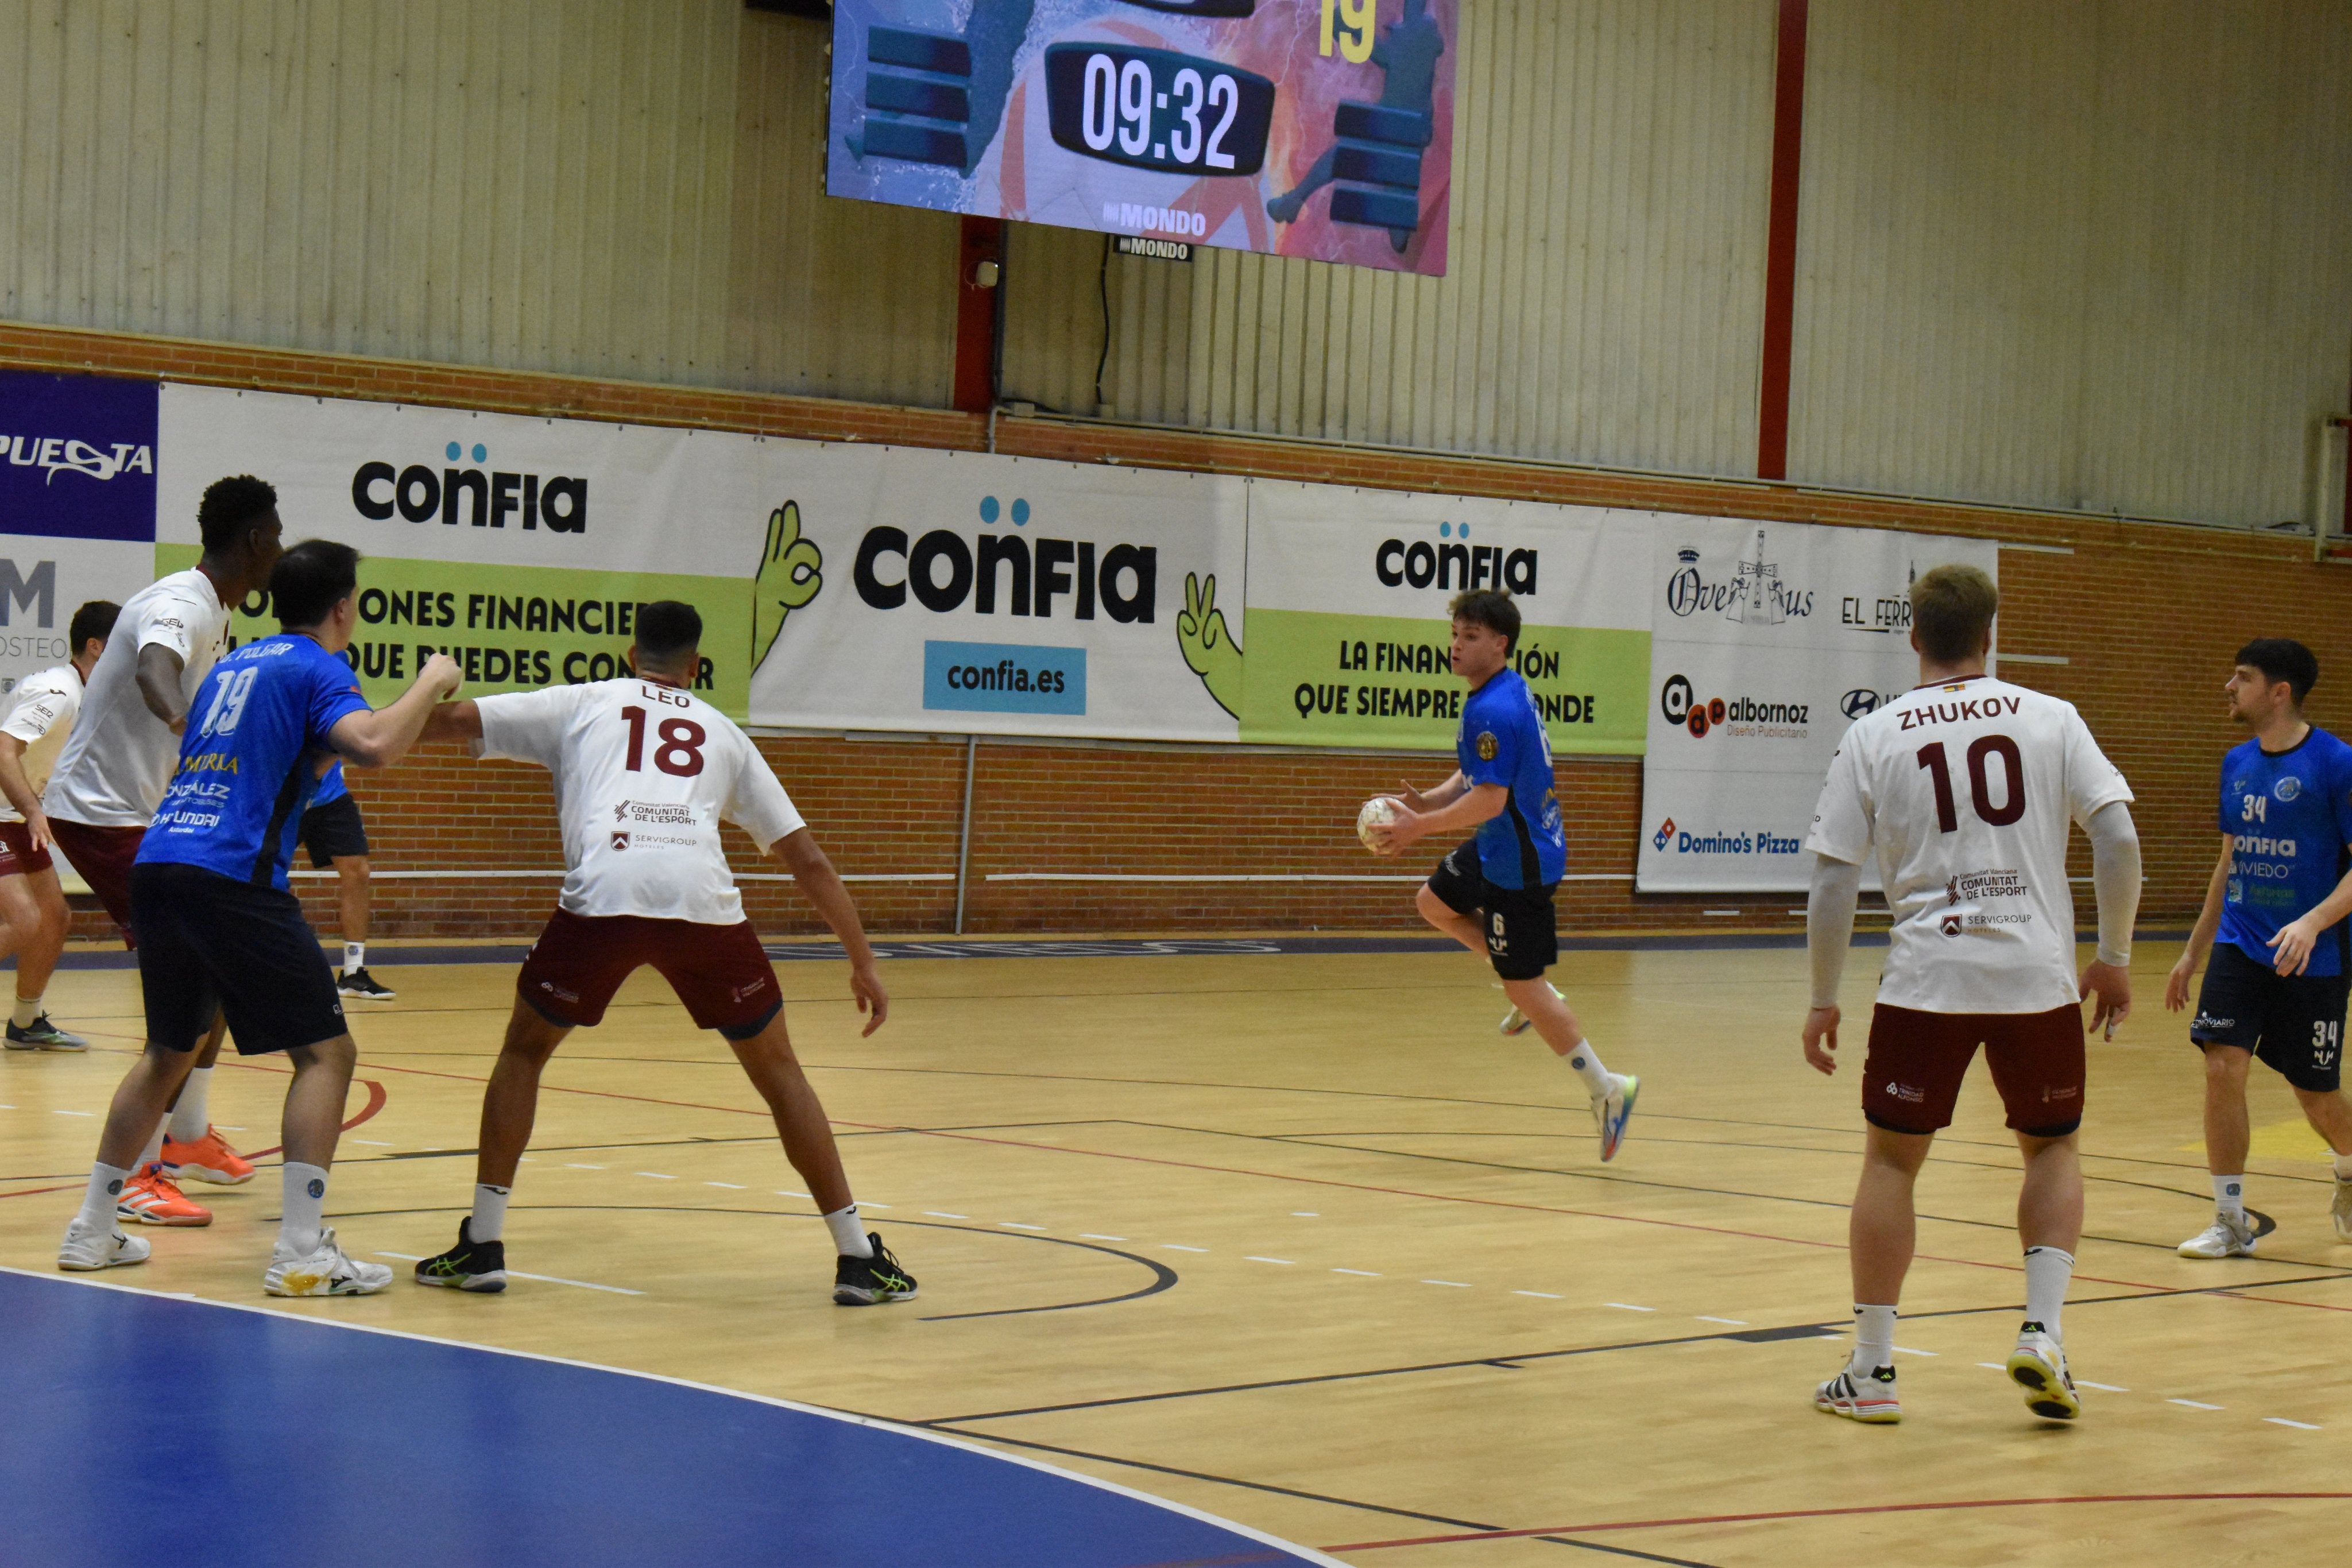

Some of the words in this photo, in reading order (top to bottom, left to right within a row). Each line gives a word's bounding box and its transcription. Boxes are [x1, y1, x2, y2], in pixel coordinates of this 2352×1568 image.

[1082, 53, 1238, 169] 09:32
[1121, 203, 1206, 236] MONDO
[1131, 238, 1187, 260] MONDO
[467, 594, 695, 635] FINANCIE
[1842, 597, 1866, 624] EL
[1875, 599, 1912, 627] FERR
[1340, 640, 1368, 671] LA
[1376, 642, 1560, 679] FINANIÓN
[947, 660, 1065, 694] confia.es
[200, 666, 258, 738] 19
[642, 686, 690, 708] LEO
[1294, 683, 1348, 719] QUE
[1357, 686, 1460, 719] SIEMPRE
[1729, 697, 1808, 724] albornoz
[1896, 696, 2021, 731] ZHUKOV
[621, 705, 706, 777] 18
[1727, 725, 1755, 738] Diseño
[1758, 726, 1808, 739] Publicitario
[165, 780, 230, 799] ONZÁLEZ
[1916, 734, 2027, 834] 10
[631, 806, 690, 816] COMUNITAT
[635, 813, 648, 822] DE
[651, 815, 697, 826] L'ESPORT
[2242, 794, 2267, 823] 34
[635, 835, 697, 846] SERVIGROUP
[1678, 831, 1755, 854] Domino's
[1757, 833, 1799, 854] Pizza
[1959, 869, 1989, 879] Comunitat
[1961, 876, 2018, 891] COMUNITAT
[1967, 889, 1979, 900] DE
[1982, 885, 2028, 897] L'ESPORT
[1492, 912, 1506, 936] 6
[1967, 914, 2032, 924] SERVIGROUP
[2312, 1020, 2338, 1048] 34
